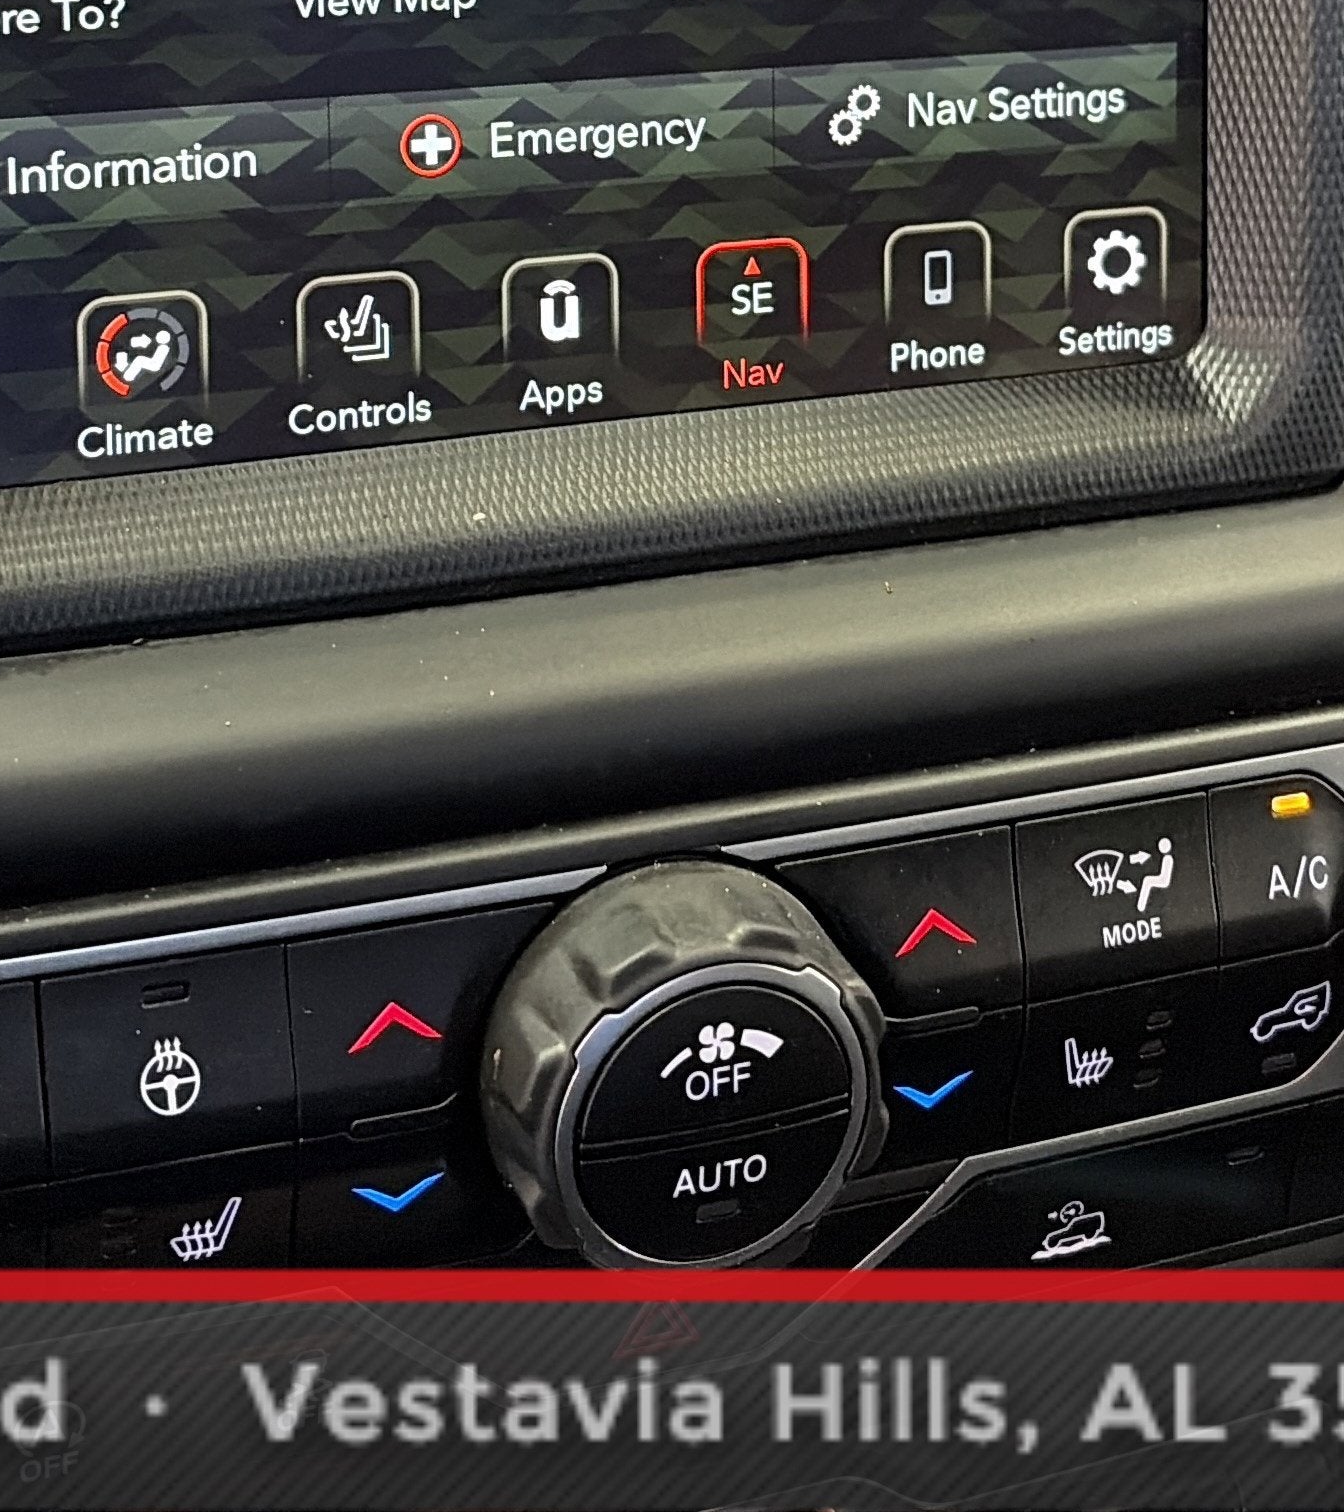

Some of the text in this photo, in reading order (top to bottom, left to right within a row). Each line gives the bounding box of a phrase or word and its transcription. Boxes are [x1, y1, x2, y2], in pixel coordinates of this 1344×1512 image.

[908, 81, 1126, 128] Nav Settings
[490, 116, 707, 159] Emergency
[7, 142, 257, 195] Information
[731, 281, 774, 316] SE
[890, 339, 986, 373] Phone
[1058, 321, 1173, 356] Settings
[723, 357, 784, 390] Nav
[288, 390, 432, 435] Controls
[519, 379, 603, 415] Apps
[77, 419, 214, 458] Climate
[1268, 855, 1329, 900] A/C
[1102, 916, 1163, 948] MODE
[684, 1061, 753, 1101] OFF
[672, 1154, 767, 1198] AUTO
